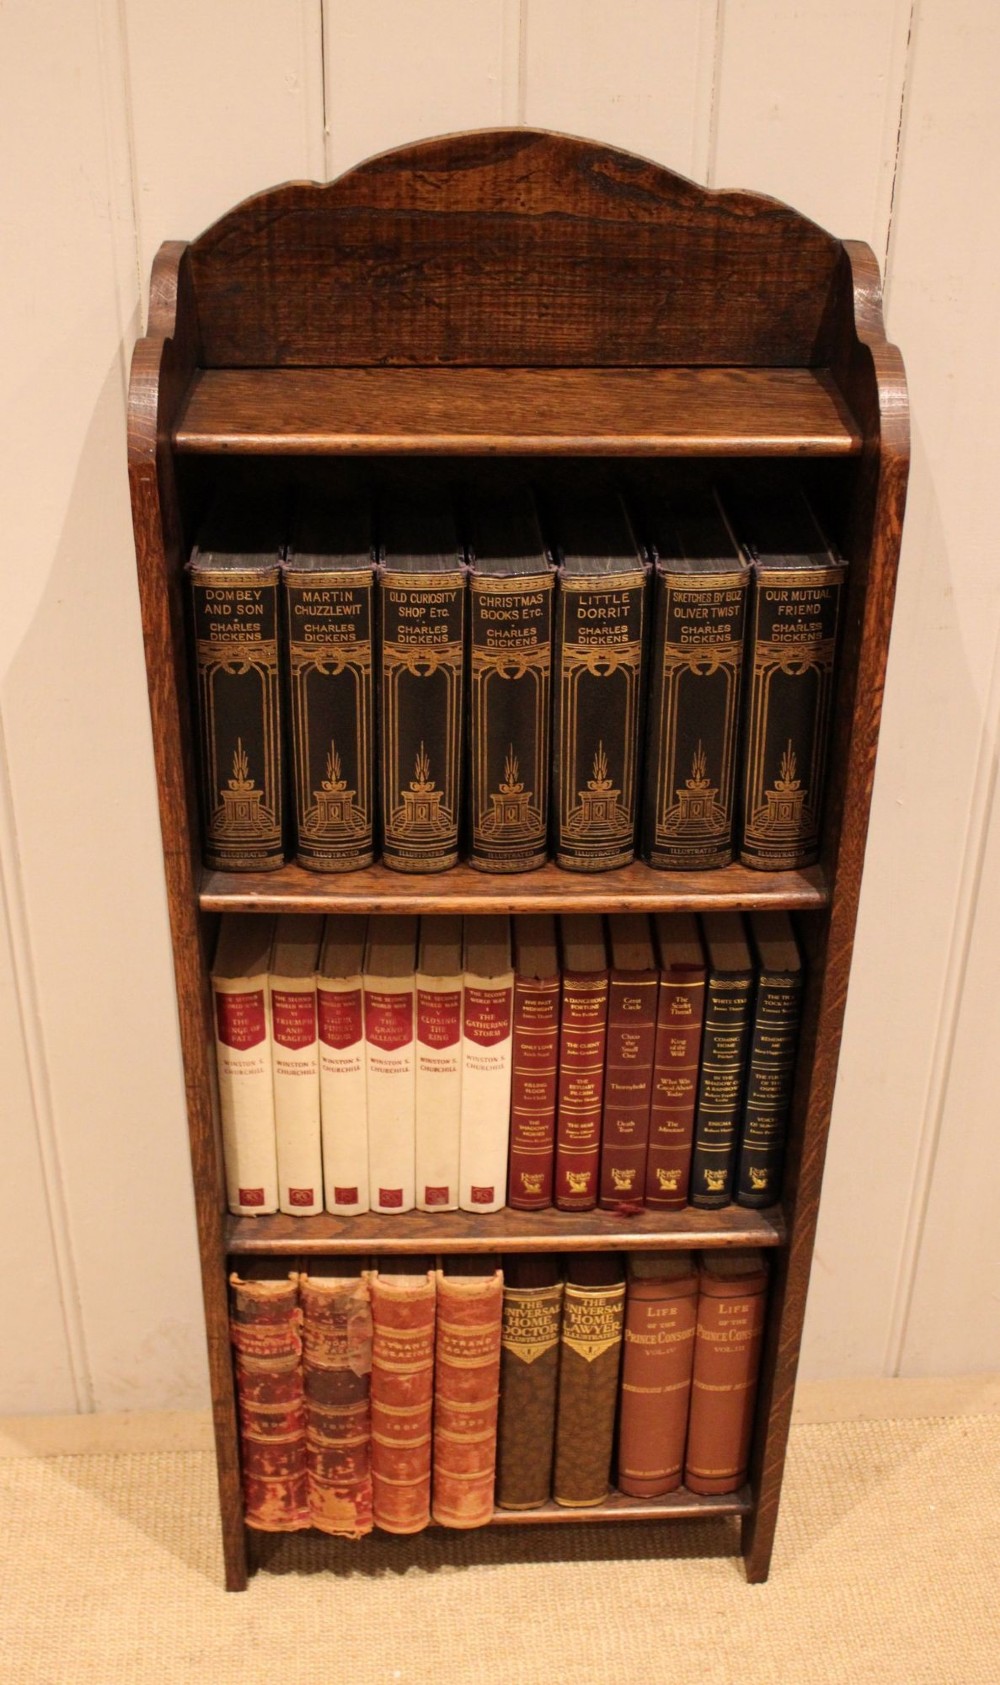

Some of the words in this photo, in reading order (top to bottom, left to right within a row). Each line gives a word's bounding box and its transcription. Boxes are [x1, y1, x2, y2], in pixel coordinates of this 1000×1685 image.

[205, 589, 262, 600] DOMBEY
[302, 591, 353, 602] MARTIN
[389, 591, 407, 603] OLD
[410, 591, 457, 604] CURIOSITY
[579, 592, 630, 605] LITTLE
[672, 592, 712, 603] SKETCHES
[713, 592, 725, 603] BY
[725, 591, 743, 602] BOZ
[765, 590, 788, 601] OUR
[791, 589, 832, 601] MUTUAL
[479, 593, 544, 608] CHRISTMAS
[204, 604, 232, 615] AND
[236, 604, 264, 615] SON
[294, 604, 362, 616] CHUZZLEWIT
[398, 606, 426, 618] SHOP
[480, 609, 519, 620] BOOKS
[577, 606, 631, 619] DORRIT
[674, 607, 709, 619] OLIVER
[710, 605, 740, 618] TWIST
[778, 604, 821, 616] FRIEND
[209, 623, 261, 632] CHARLES
[304, 624, 355, 633] CHARLES
[397, 625, 448, 634] CHARLES
[486, 627, 537, 638] CHARLES
[578, 625, 628, 635] CHARLES
[681, 624, 731, 634] CHARLES
[771, 623, 823, 633] CHARLES
[210, 632, 262, 641] DICKENS
[304, 633, 356, 642] DICKENS
[397, 634, 449, 644] DICKENS
[487, 636, 538, 647] DICKENS
[578, 634, 629, 644] DICKENS
[681, 633, 731, 643] DICKENS
[771, 632, 823, 642] DICKENS
[465, 1019, 509, 1030] GATHERING
[473, 1029, 501, 1037] STORM
[518, 1301, 544, 1309] THE
[582, 1298, 607, 1306] THE
[508, 1315, 553, 1327] HOME
[570, 1313, 614, 1325] HOME
[562, 1320, 622, 1334] LAWYER
[443, 1336, 492, 1347] STRAND
